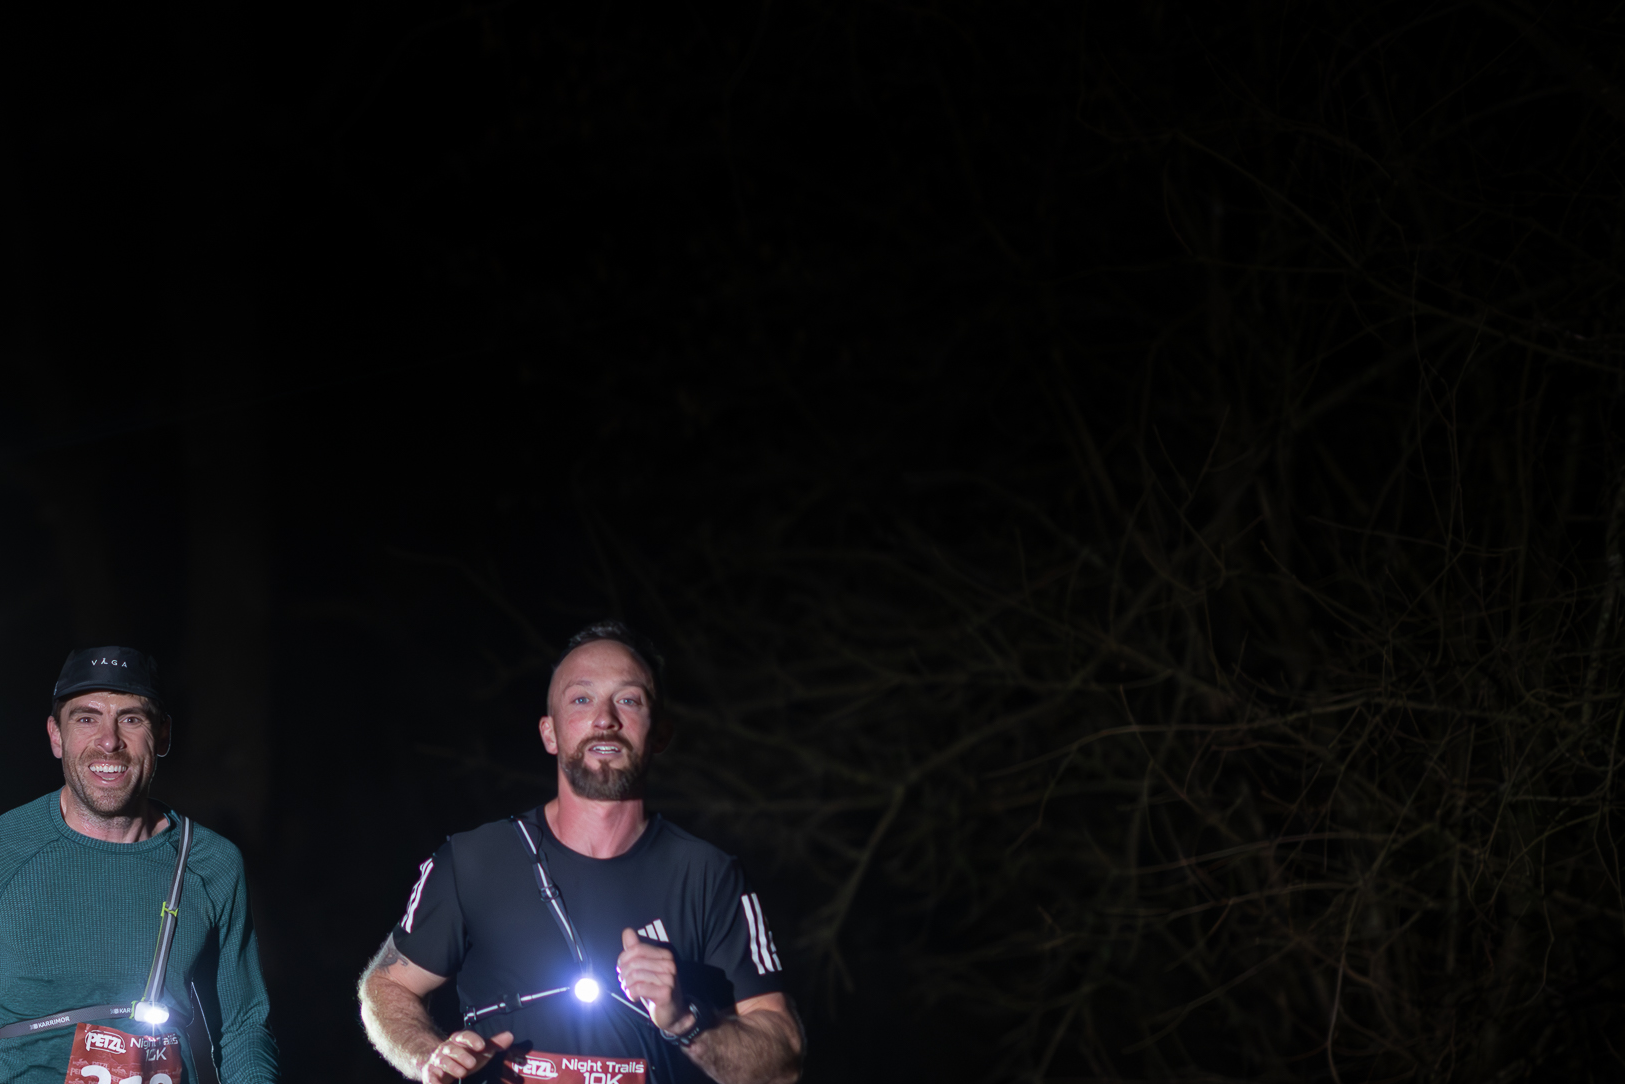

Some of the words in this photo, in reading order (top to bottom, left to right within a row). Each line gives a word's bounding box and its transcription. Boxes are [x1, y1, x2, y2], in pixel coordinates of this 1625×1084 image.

[38, 1016, 70, 1028] KARRIMOR
[85, 1032, 126, 1053] PETZL
[562, 1058, 603, 1073] Night
[606, 1061, 645, 1073] Trails
